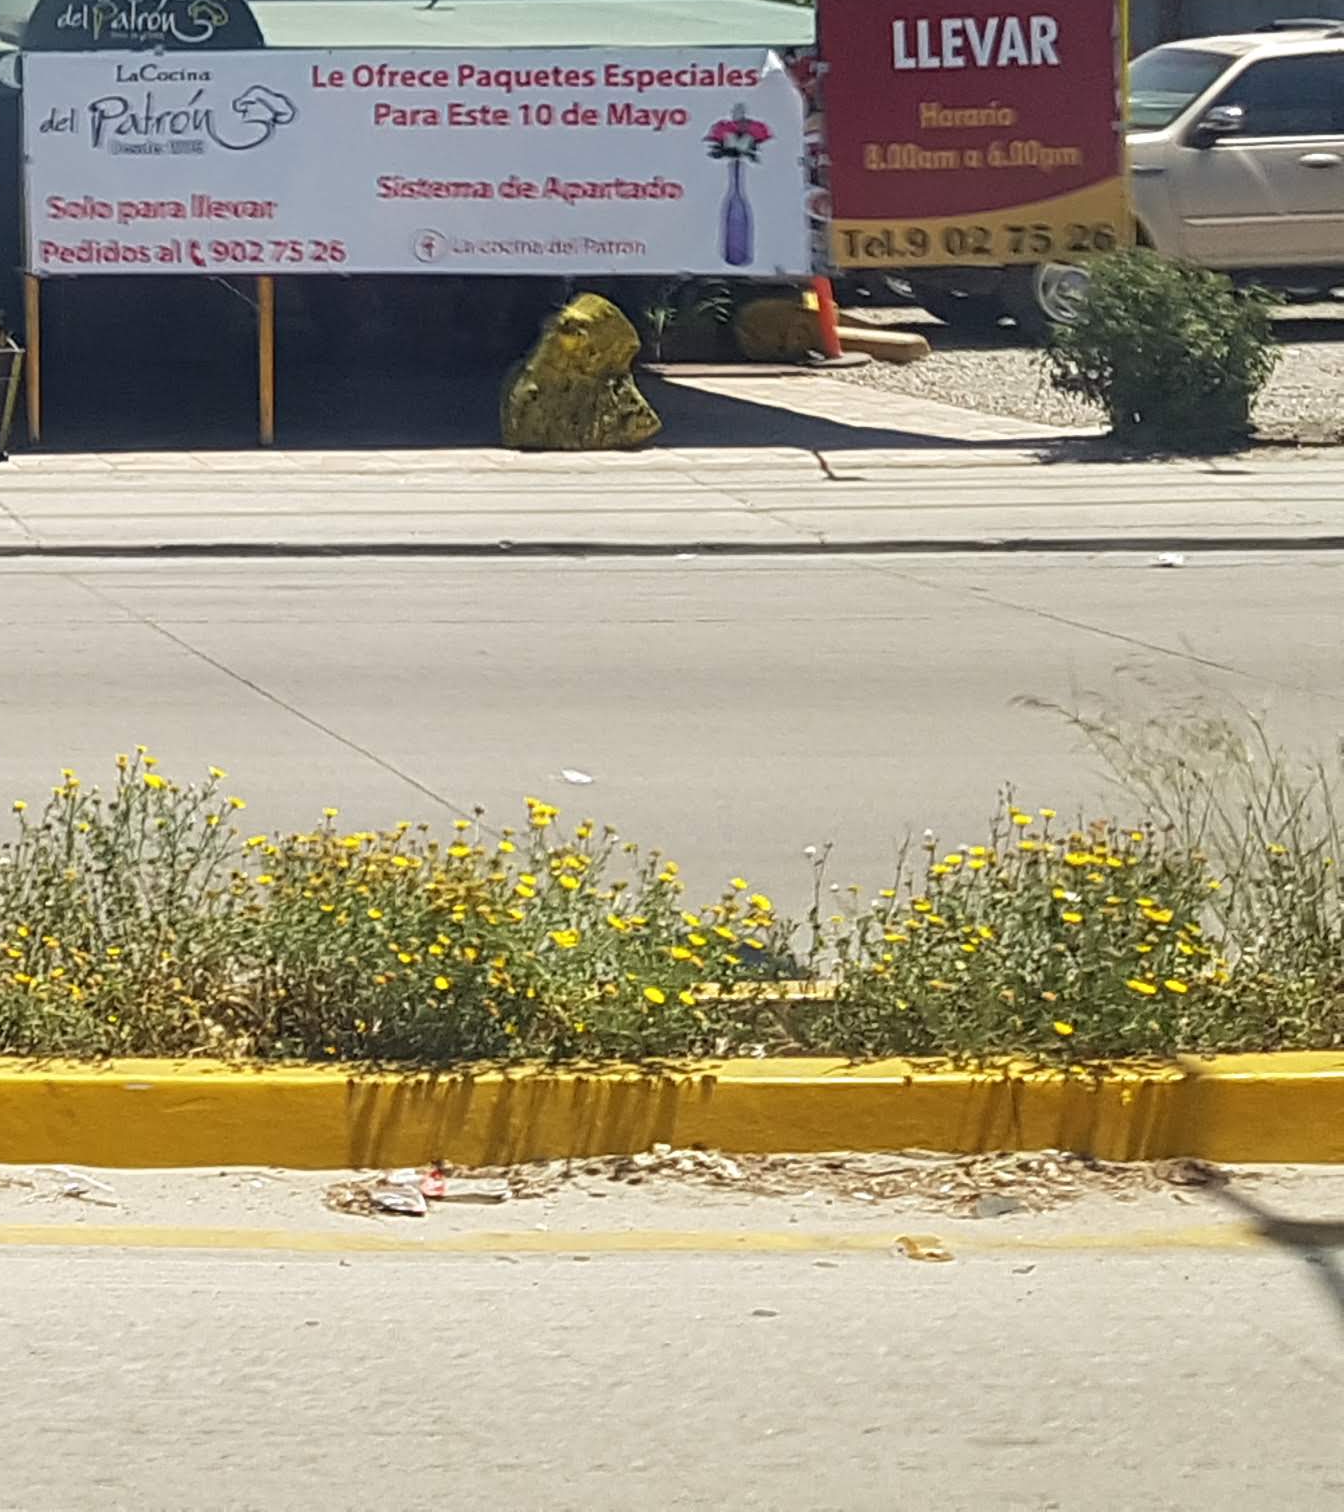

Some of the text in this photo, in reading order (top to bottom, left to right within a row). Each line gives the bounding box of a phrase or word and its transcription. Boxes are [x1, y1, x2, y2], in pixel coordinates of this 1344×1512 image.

[57, 3, 88, 32] del
[891, 15, 1060, 70] LLEVAR
[311, 62, 760, 93] Le Ofrece Paquetes Especiales
[39, 88, 216, 148] del Patrón
[373, 101, 688, 132] Para Este 10 de Mayo
[920, 100, 1016, 129] Horario
[376, 175, 685, 205] Sistema de Apartado
[46, 194, 279, 225] Solo para llevar
[39, 239, 347, 264] Pedidos al 902 75 26
[944, 226, 993, 256] 02
[1007, 222, 1053, 255] 75
[1062, 222, 1116, 254] 26
